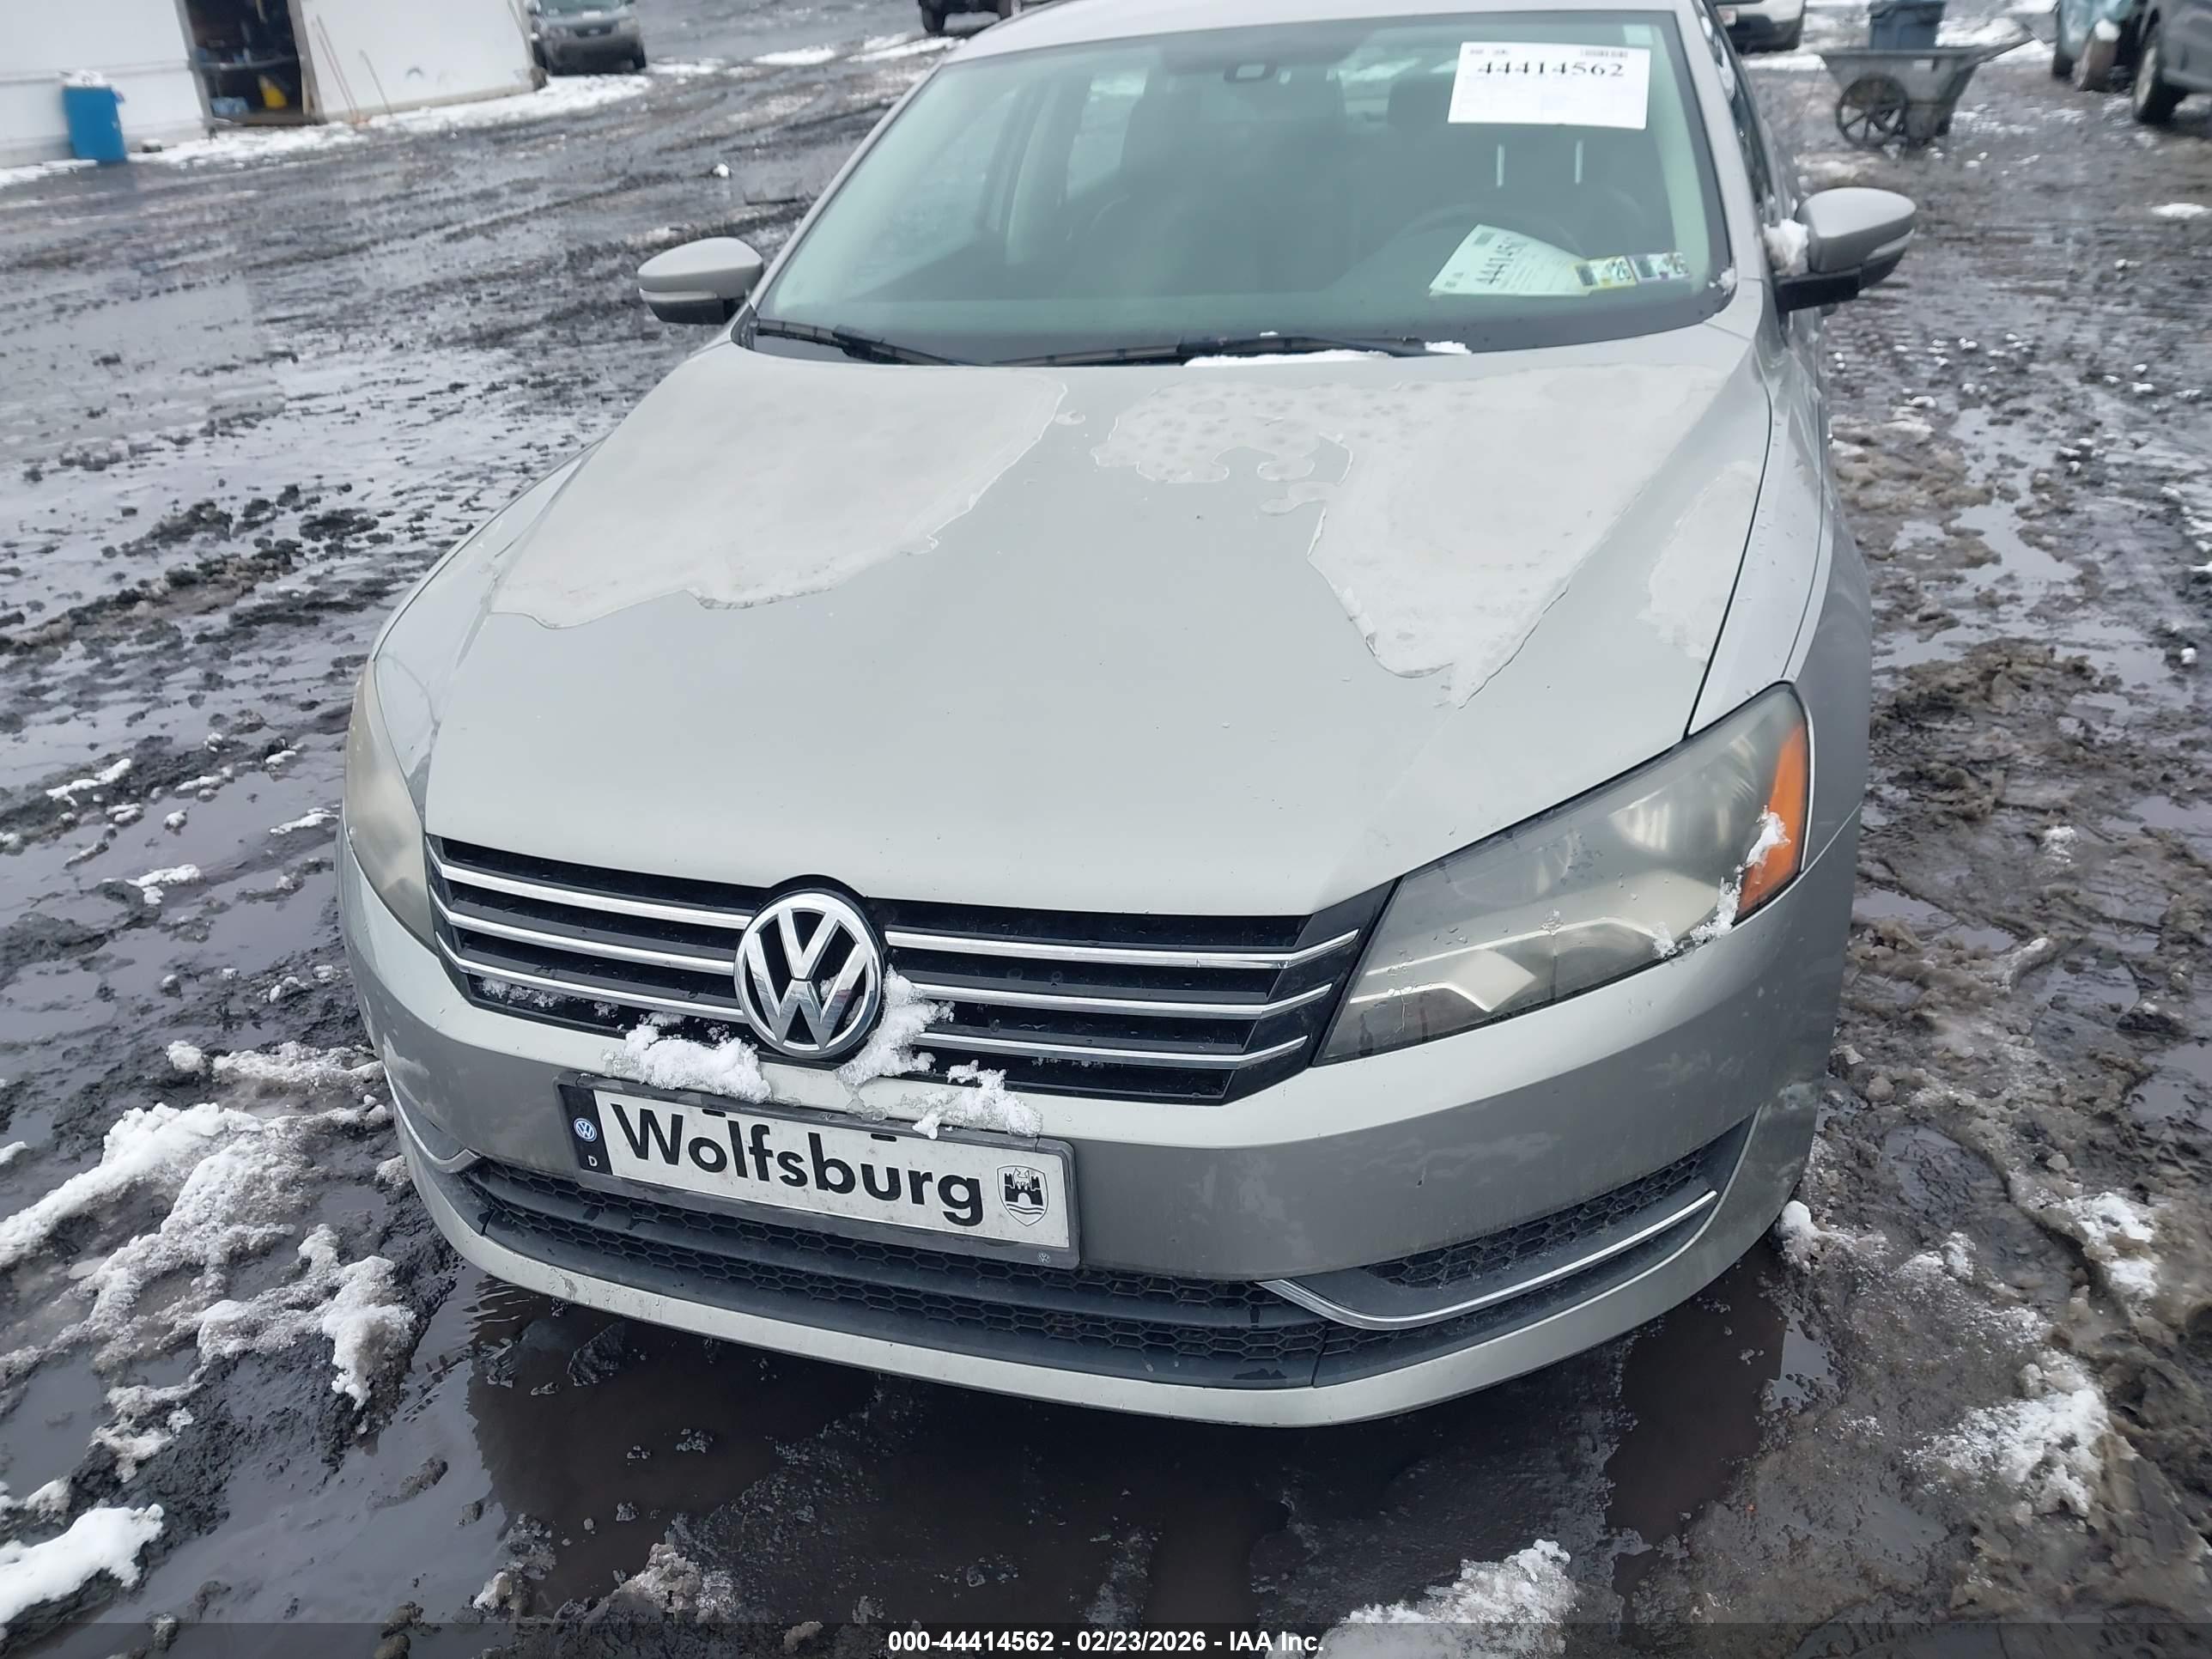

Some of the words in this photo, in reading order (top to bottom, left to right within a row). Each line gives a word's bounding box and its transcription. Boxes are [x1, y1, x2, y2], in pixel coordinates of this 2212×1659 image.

[1477, 60, 1626, 78] 44414562
[587, 1155, 598, 1167] D
[611, 1103, 983, 1227] Wolfsburg
